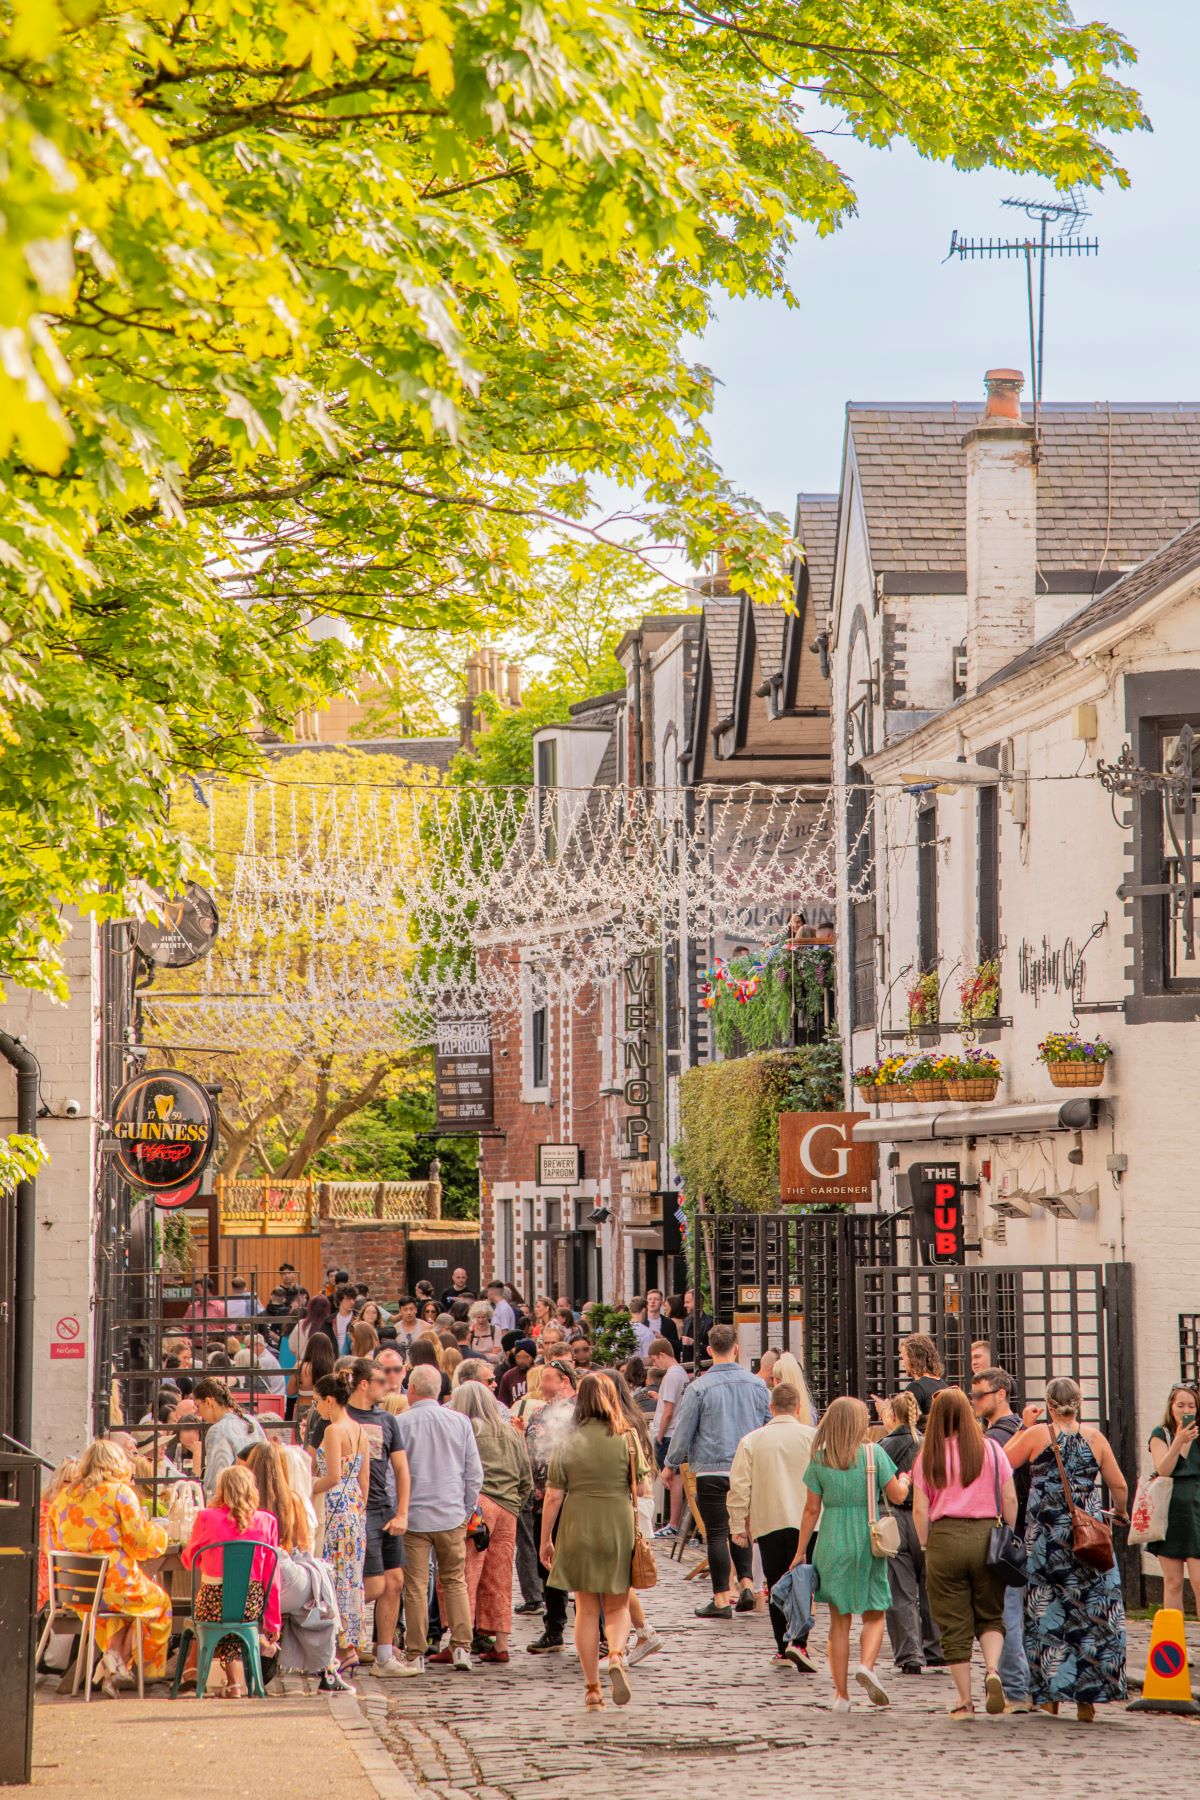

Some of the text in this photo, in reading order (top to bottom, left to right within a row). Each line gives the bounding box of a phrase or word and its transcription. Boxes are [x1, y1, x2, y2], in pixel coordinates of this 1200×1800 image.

[439, 1039, 490, 1054] TAPROOM
[147, 1110, 183, 1121] 17 59
[114, 1122, 209, 1141] GUINNESS
[800, 1123, 853, 1179] G
[543, 1159, 575, 1168] BREWERY
[543, 1168, 575, 1177] TAPROOM
[925, 1168, 957, 1180] THE
[786, 1186, 868, 1195] THE GARDENER
[934, 1183, 957, 1255] PUB
[745, 1290, 795, 1300] OYTES
